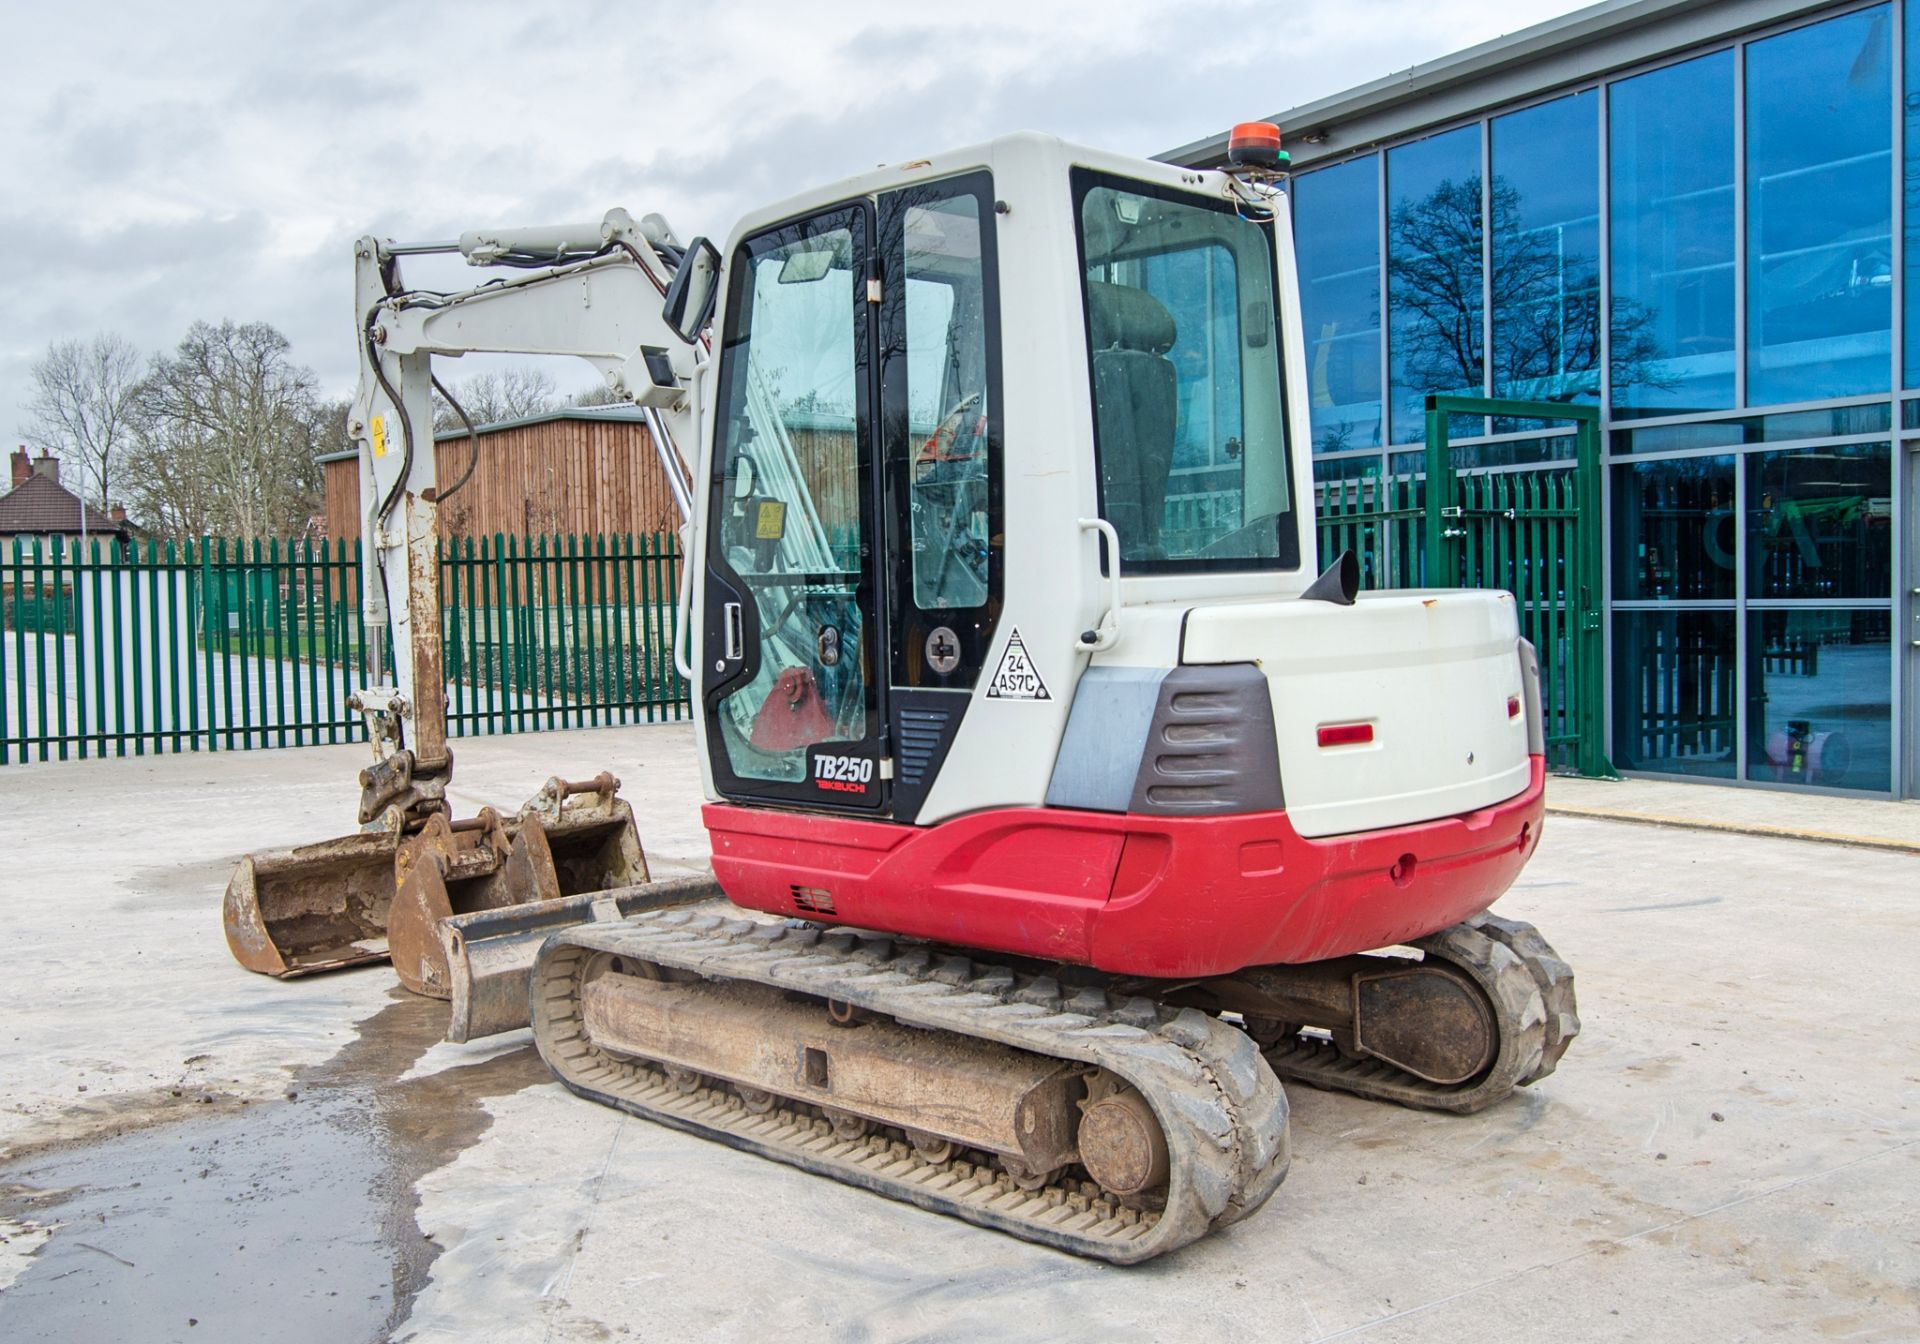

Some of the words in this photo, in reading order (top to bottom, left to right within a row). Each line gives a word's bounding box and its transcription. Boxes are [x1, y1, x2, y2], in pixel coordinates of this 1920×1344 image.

[1008, 655, 1025, 673] 24
[999, 674, 1035, 692] AS7C
[814, 754, 873, 783] TB250
[815, 780, 866, 793] TAKEUCHI
